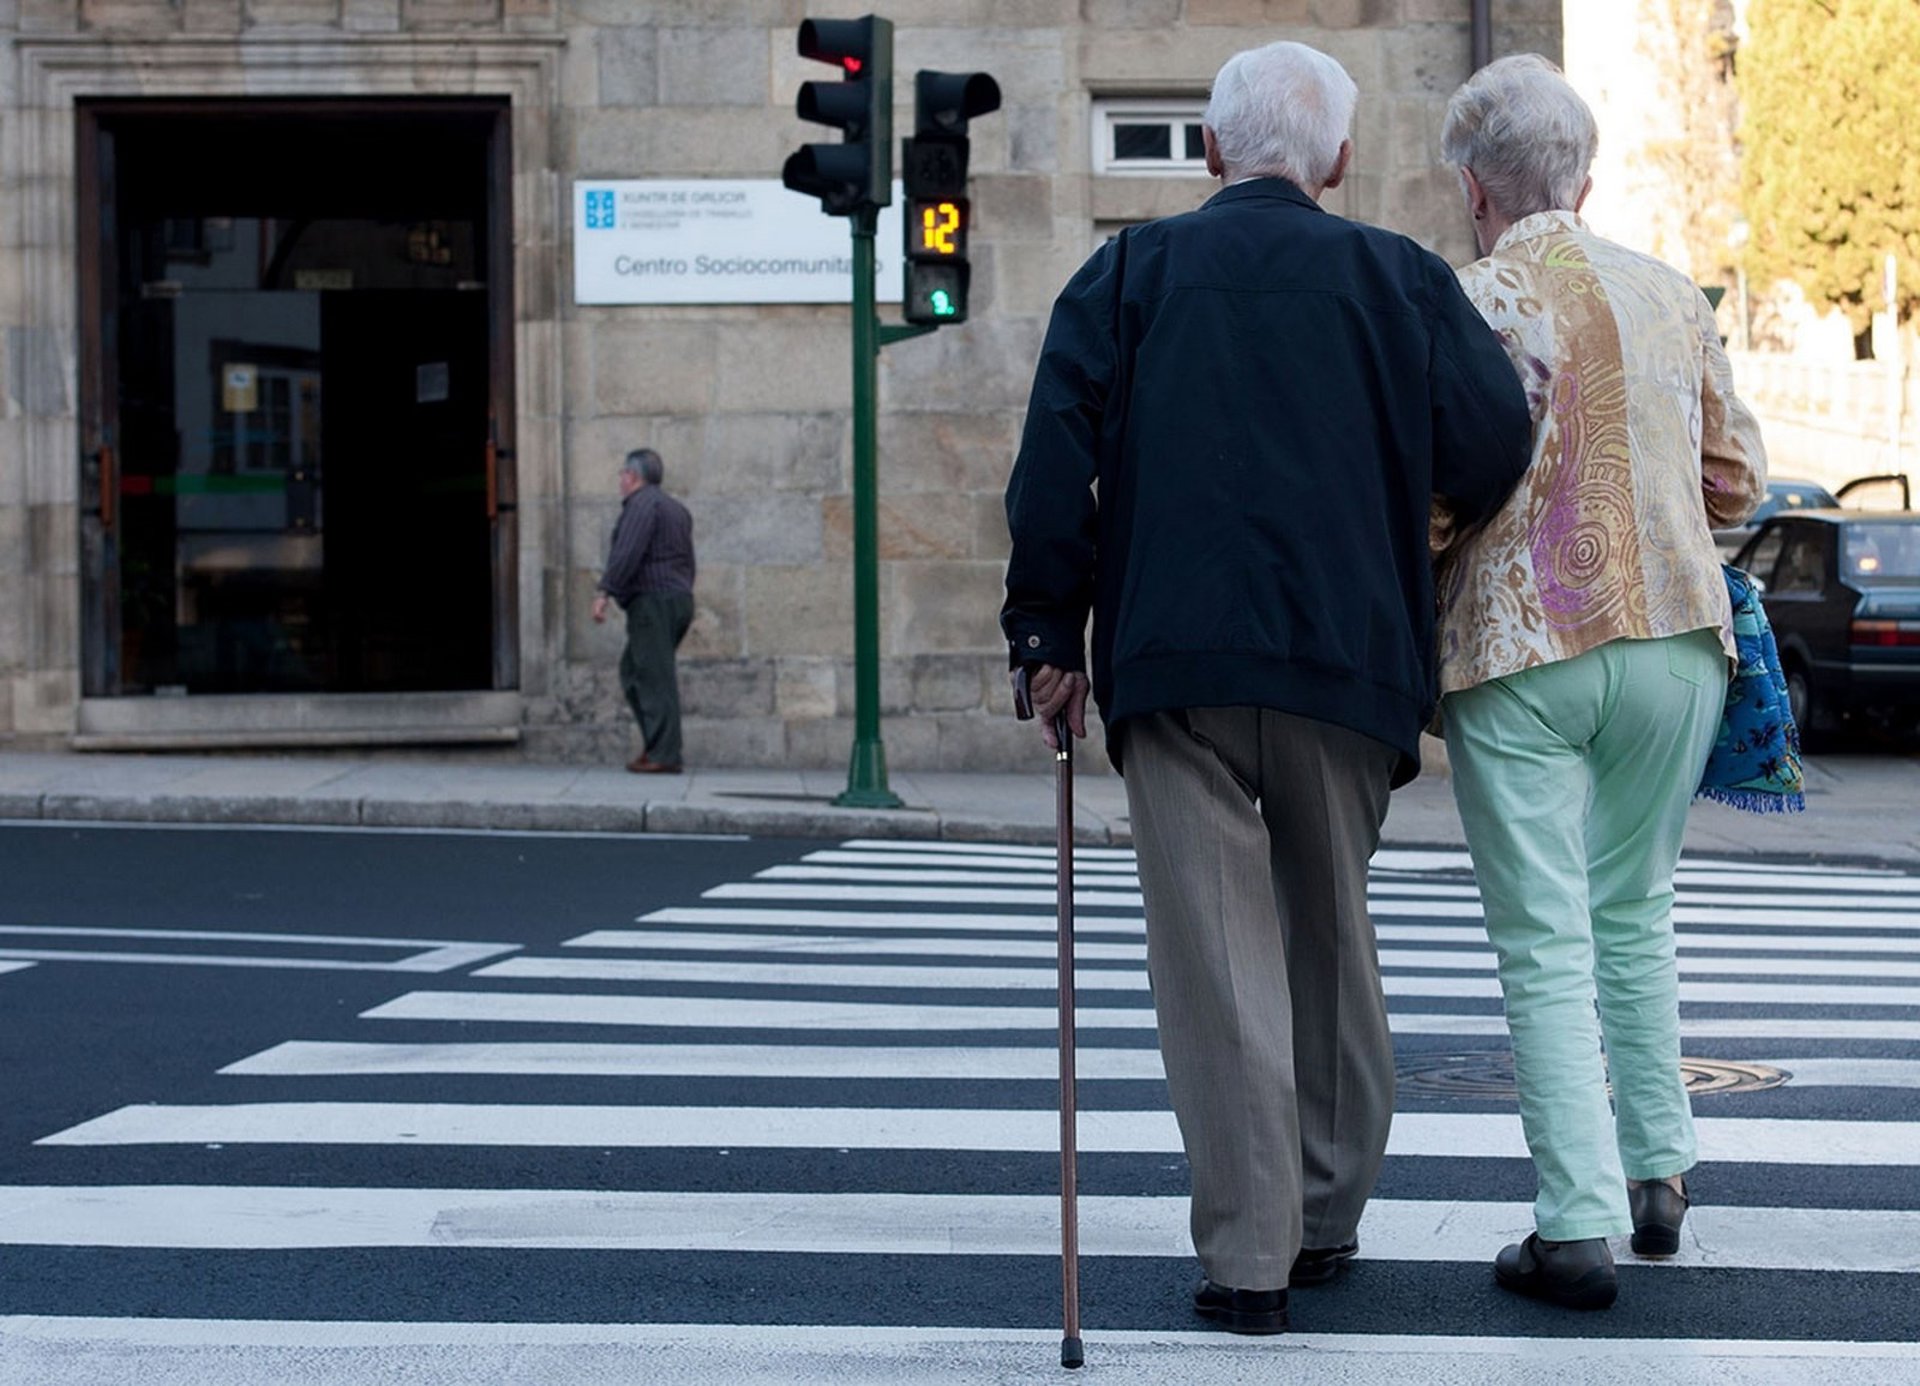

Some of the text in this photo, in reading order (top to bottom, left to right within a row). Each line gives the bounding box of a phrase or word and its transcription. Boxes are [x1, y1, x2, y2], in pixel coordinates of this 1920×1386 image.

[671, 191, 686, 204] DE
[923, 202, 960, 254] 12
[614, 254, 884, 276] Centro Sociocomunitao
